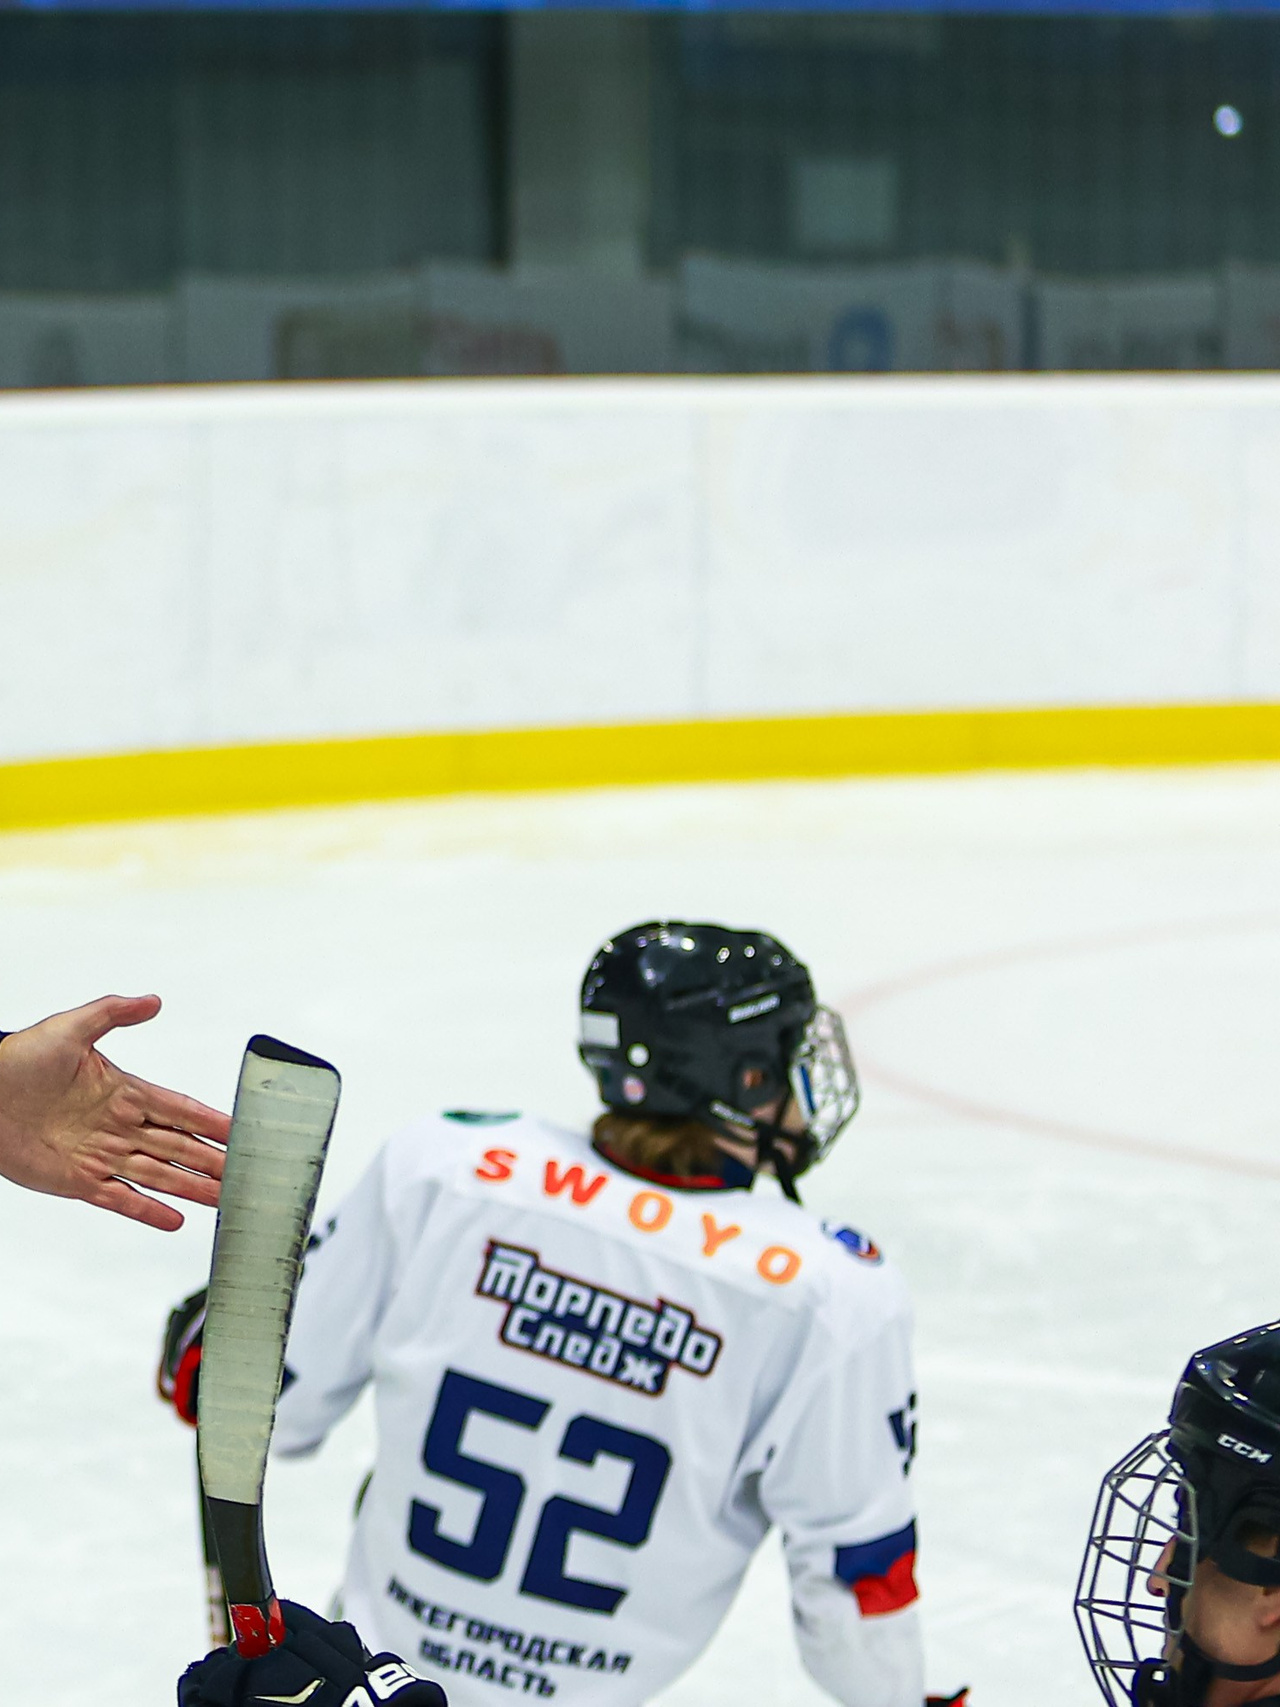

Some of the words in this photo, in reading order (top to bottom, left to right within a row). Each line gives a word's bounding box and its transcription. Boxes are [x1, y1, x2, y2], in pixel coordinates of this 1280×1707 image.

[475, 1148, 802, 1284] SWOYO
[481, 1246, 720, 1374] Торпедо
[504, 1305, 664, 1393] Следж
[407, 1369, 672, 1616] 52
[1217, 1433, 1272, 1463] CCM
